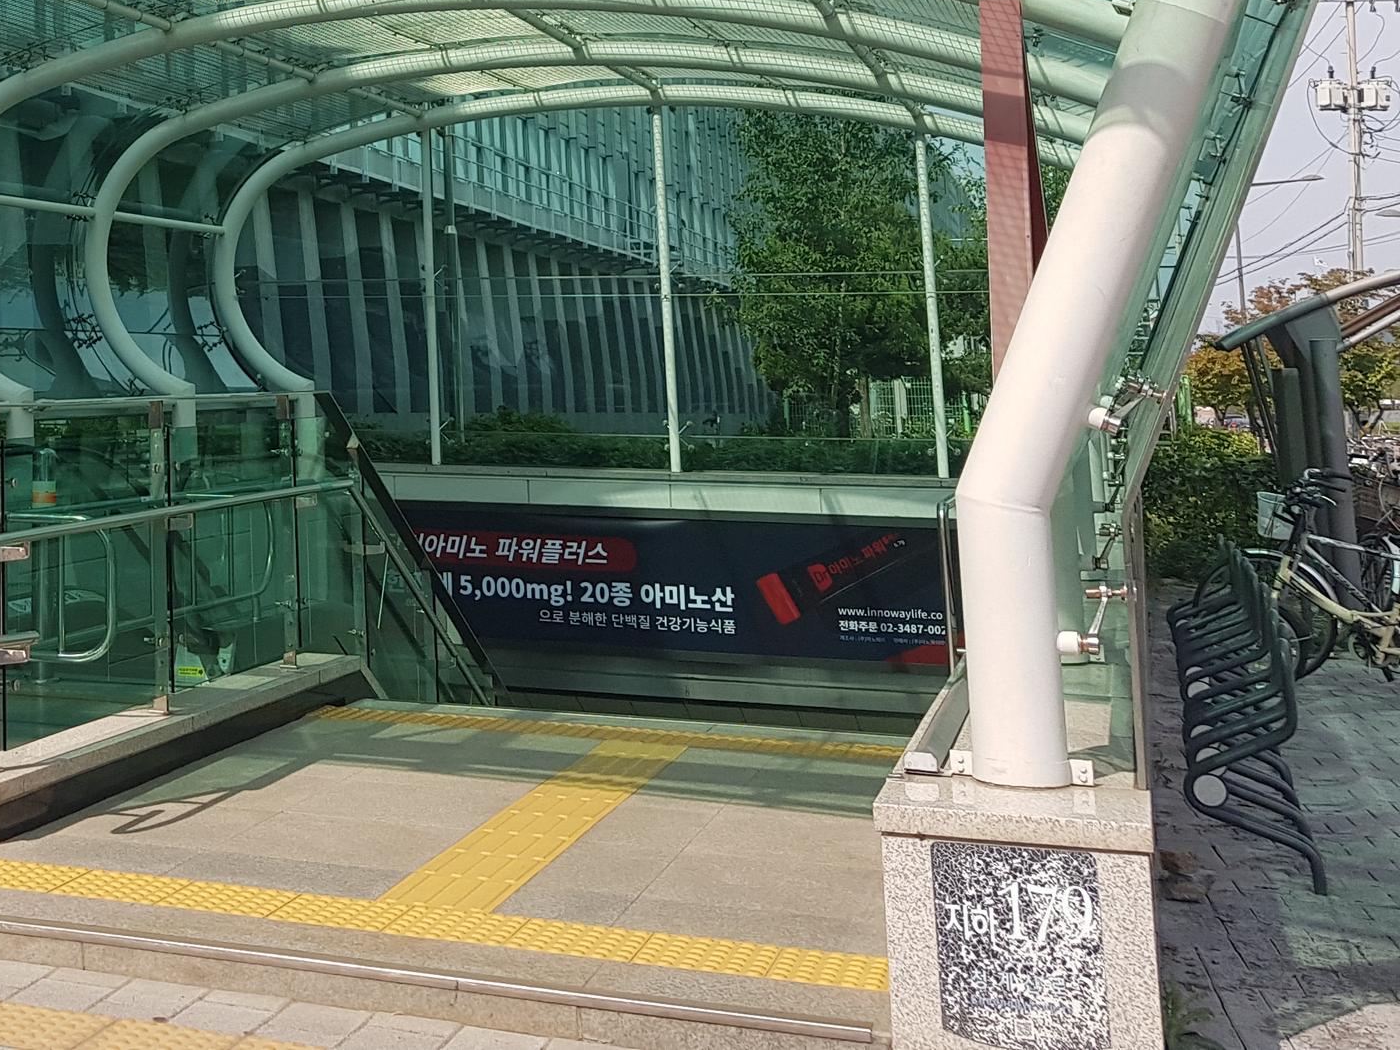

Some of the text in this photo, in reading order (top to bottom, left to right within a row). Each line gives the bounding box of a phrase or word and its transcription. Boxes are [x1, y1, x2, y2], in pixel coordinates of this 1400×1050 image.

[495, 537, 609, 566] 파워플러스
[459, 574, 574, 608] 5,000mg!
[579, 580, 634, 608] 20종
[638, 582, 736, 613] 아미노산
[539, 609, 737, 636] 으로 분해한 단백질 건강기능식품
[837, 606, 944, 621] www.innowaylife.co
[838, 619, 946, 636] 전화주문 02-3487-002
